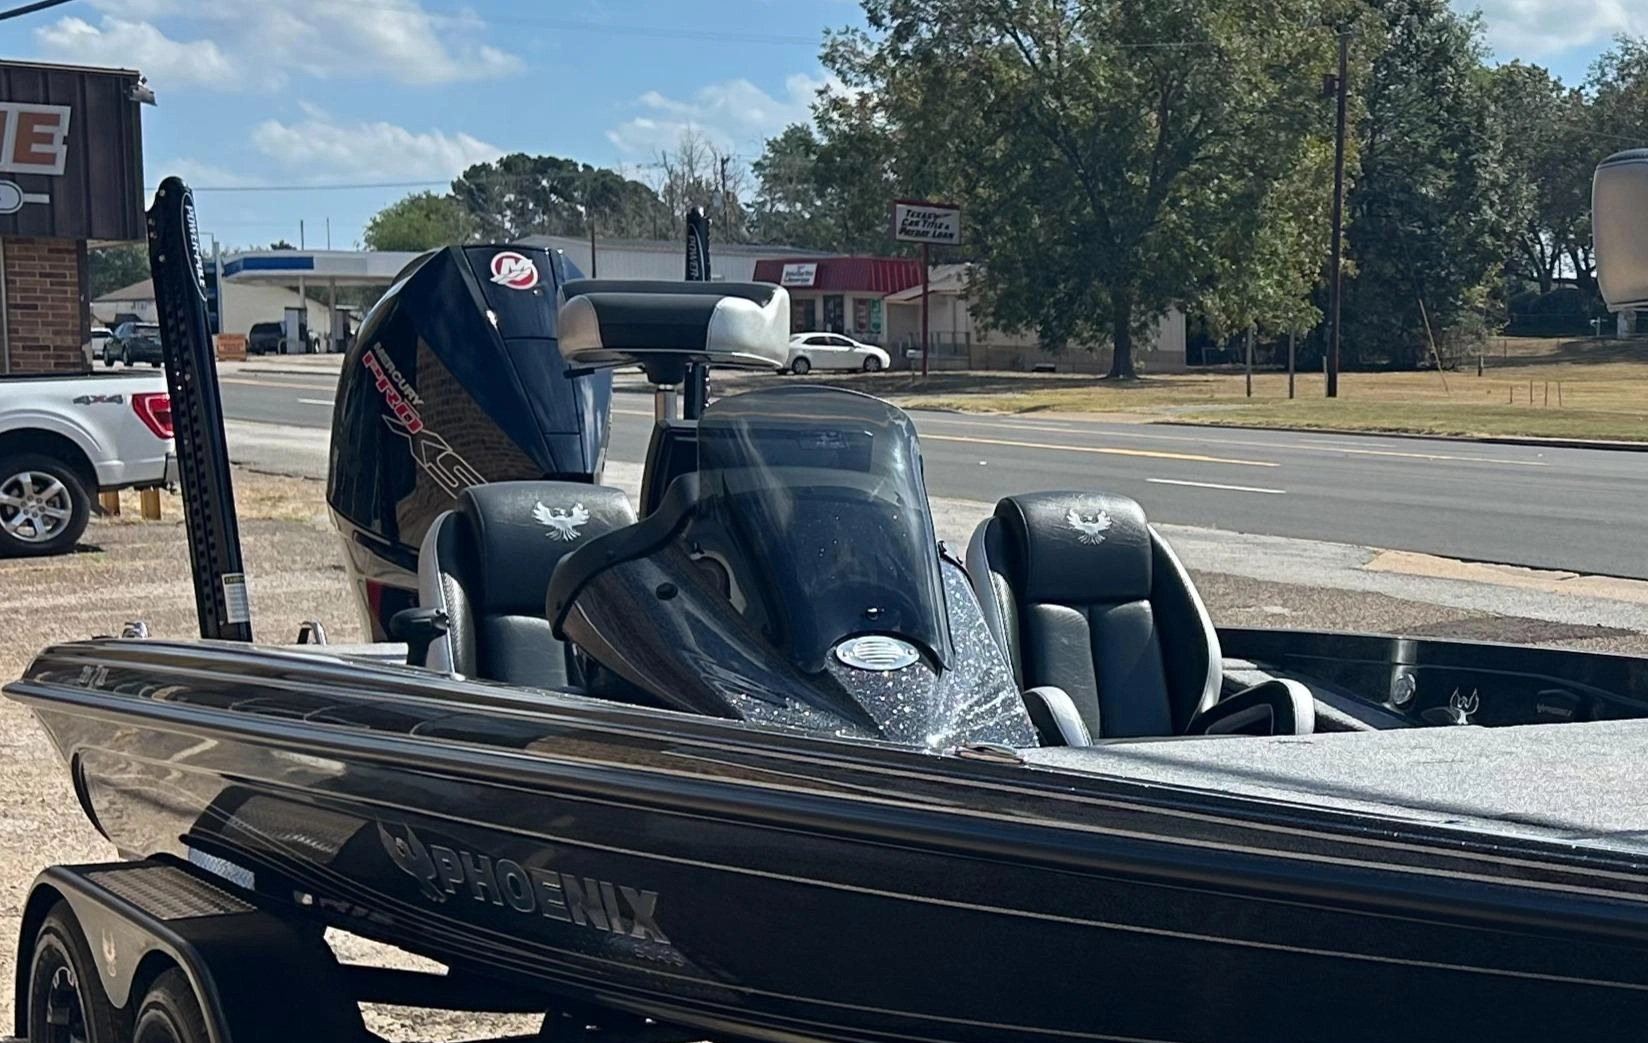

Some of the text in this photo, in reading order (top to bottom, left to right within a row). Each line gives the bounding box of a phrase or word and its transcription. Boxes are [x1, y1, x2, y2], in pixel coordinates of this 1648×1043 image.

[0, 102, 71, 175] E
[185, 204, 206, 288] POWER-POLE
[362, 350, 423, 434] PRO
[374, 342, 424, 405] MERCURY
[430, 844, 671, 945] PHOENIX
